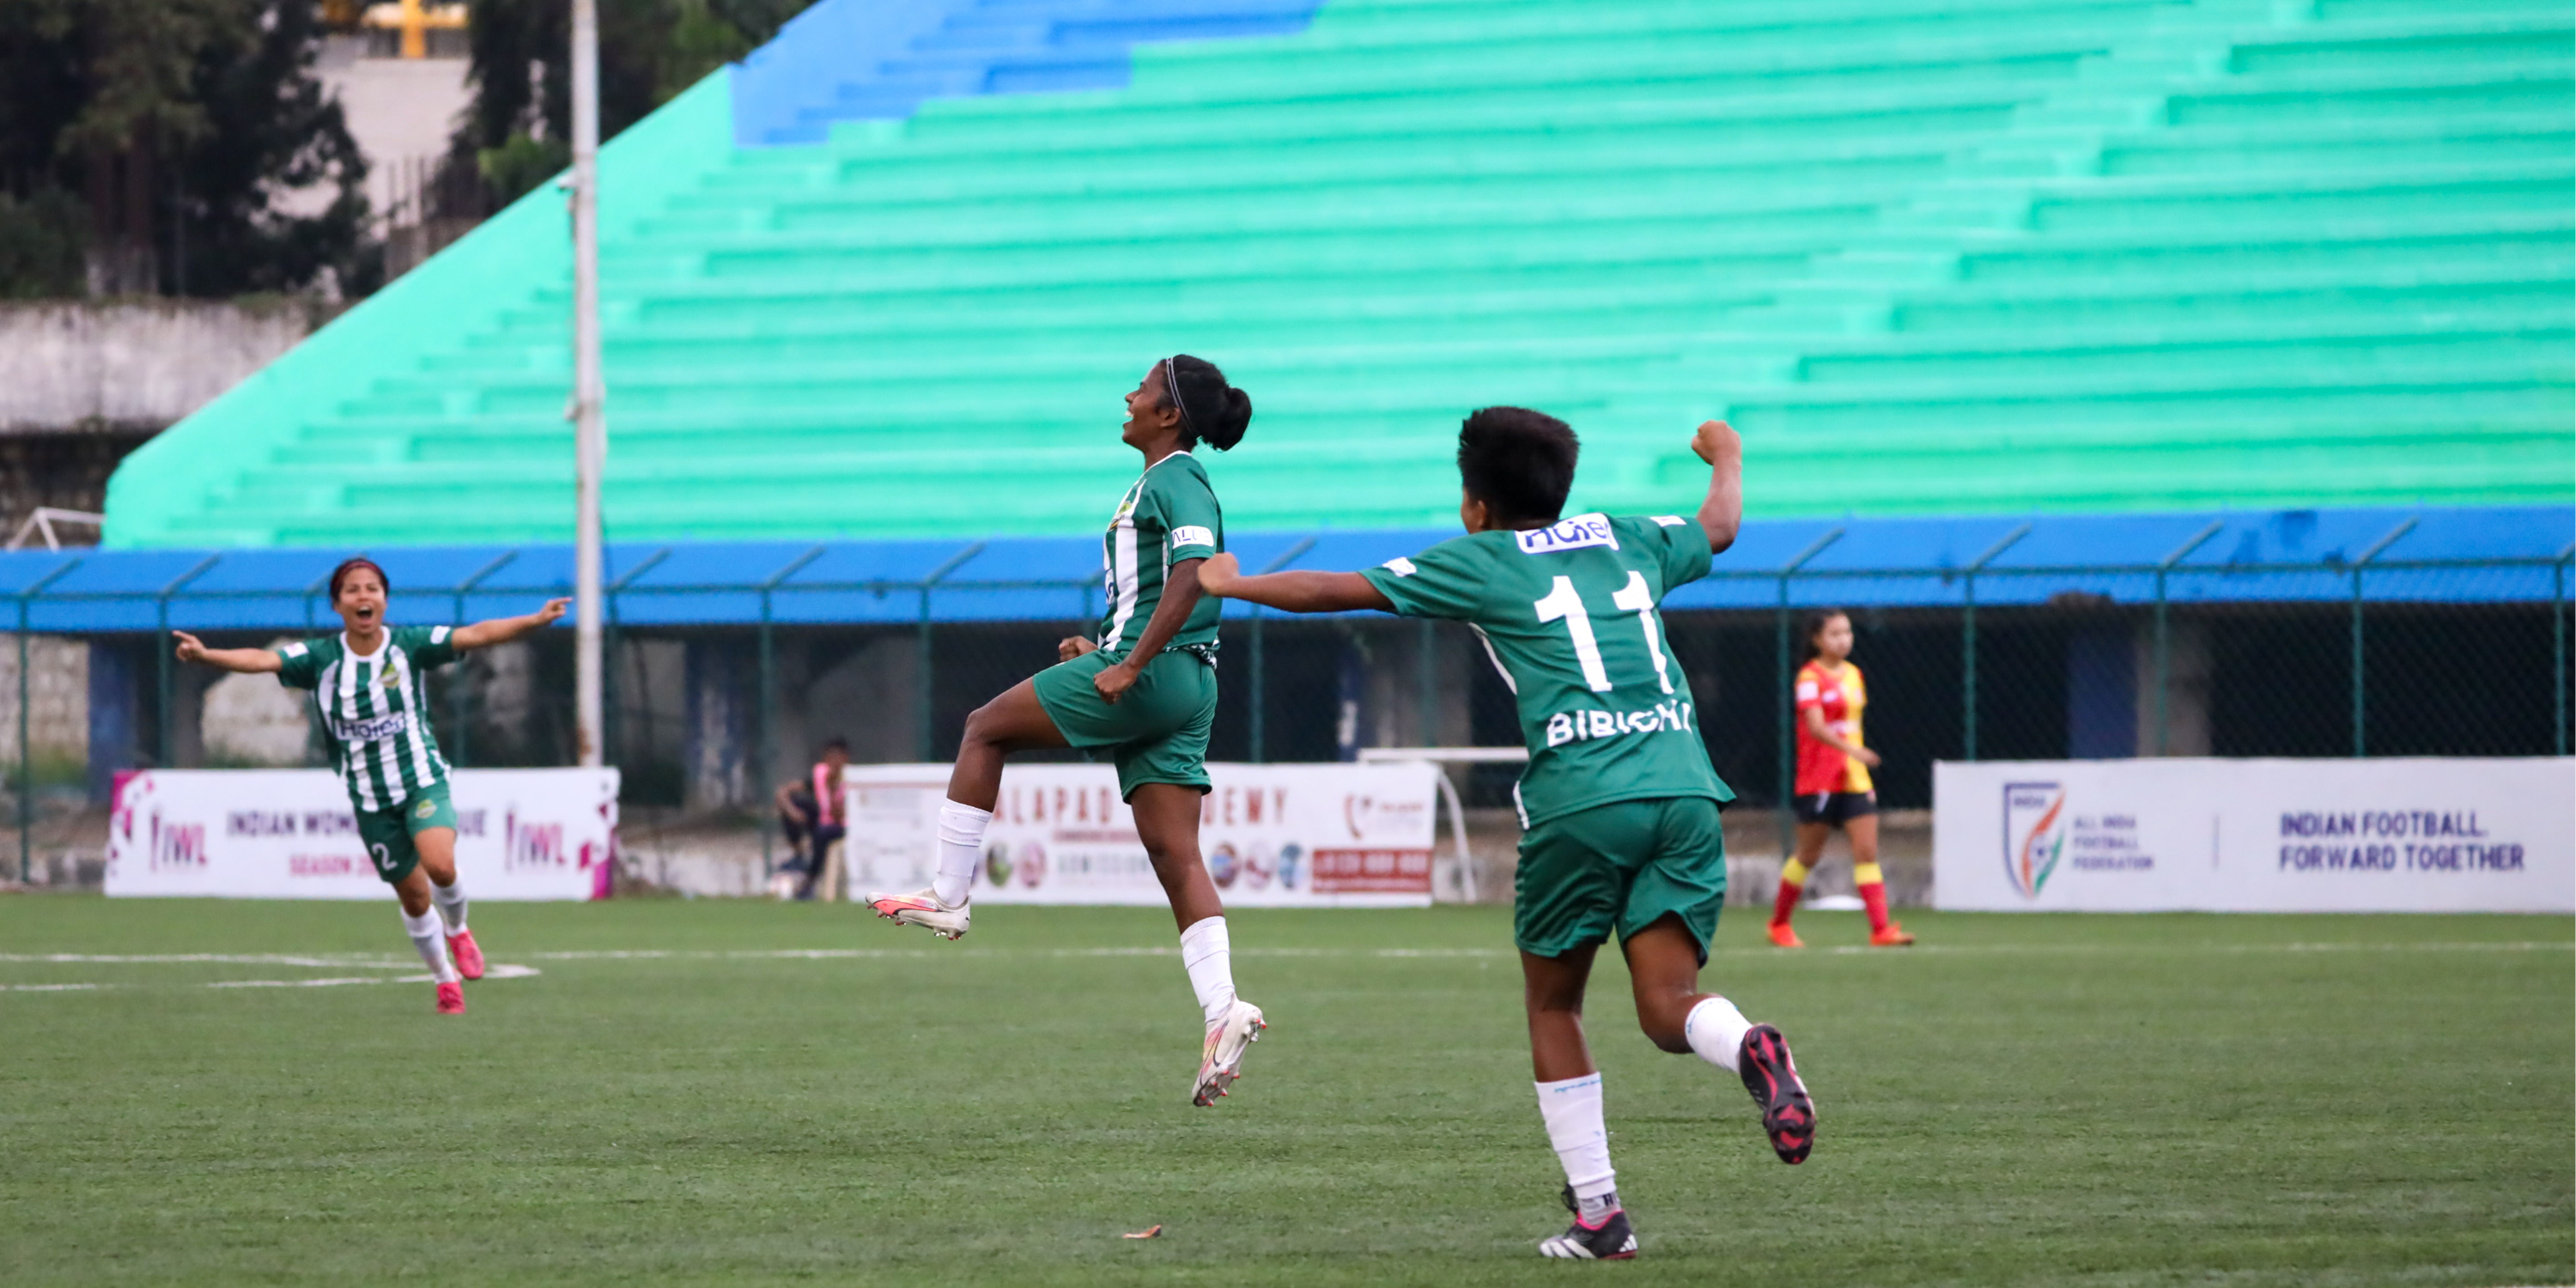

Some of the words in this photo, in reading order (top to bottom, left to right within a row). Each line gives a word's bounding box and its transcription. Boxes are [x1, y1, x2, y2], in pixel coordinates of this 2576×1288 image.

[1534, 570, 1674, 695] 11
[227, 810, 295, 835] INDIAN
[2073, 816, 2096, 829] ALL
[2103, 816, 2136, 829] INDIA
[2281, 812, 2355, 836] INDIAN
[2073, 836, 2139, 848] FOOTBALL
[371, 842, 398, 871] 2
[2073, 857, 2154, 870] FEDERATION
[2280, 845, 2397, 870] FORWARD
[2405, 845, 2524, 870] TOGETHER
